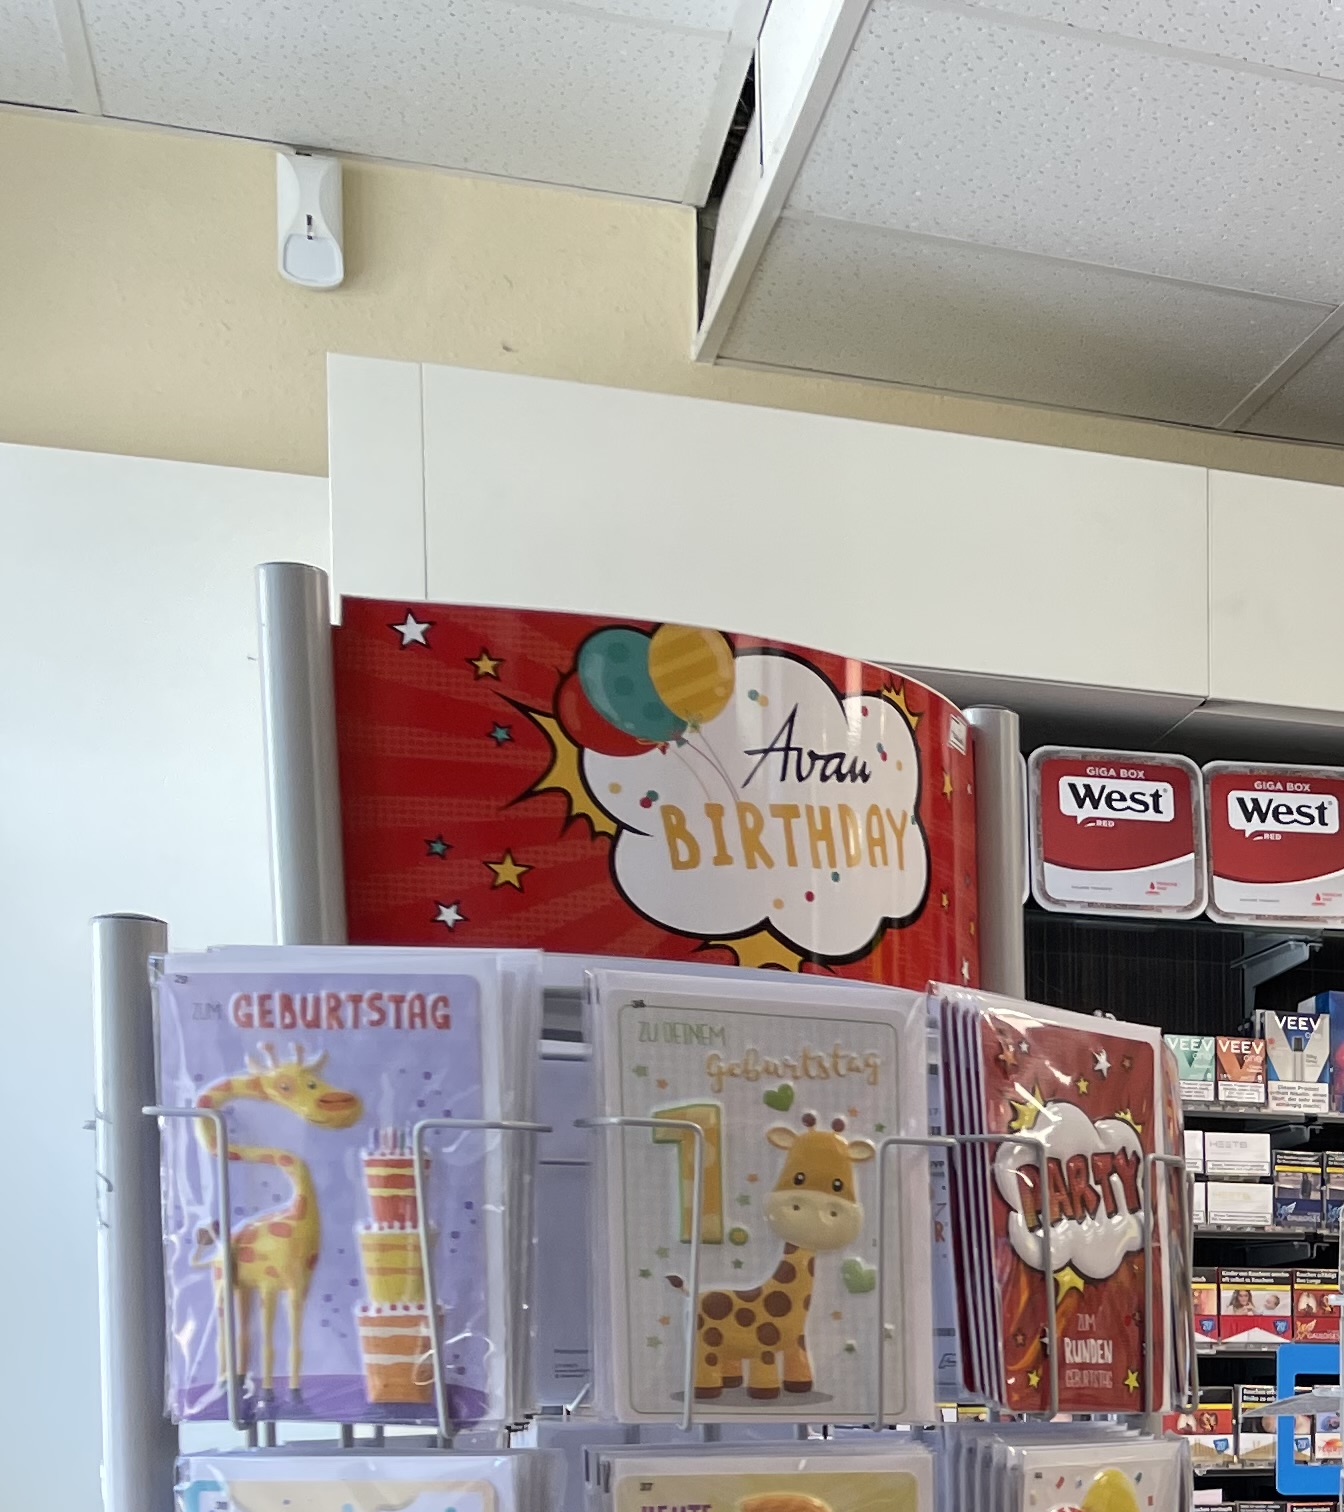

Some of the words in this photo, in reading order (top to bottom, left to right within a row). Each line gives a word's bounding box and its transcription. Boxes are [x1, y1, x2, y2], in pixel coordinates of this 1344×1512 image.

[1068, 783, 1167, 815] West
[1237, 797, 1332, 827] West
[659, 803, 910, 872] BIRTHDAY
[230, 991, 452, 1031] GEBURTSTAG
[1218, 1040, 1264, 1055] VEEV
[1016, 1146, 1142, 1232] PARTY
[1065, 1338, 1112, 1363] RUNDEN
